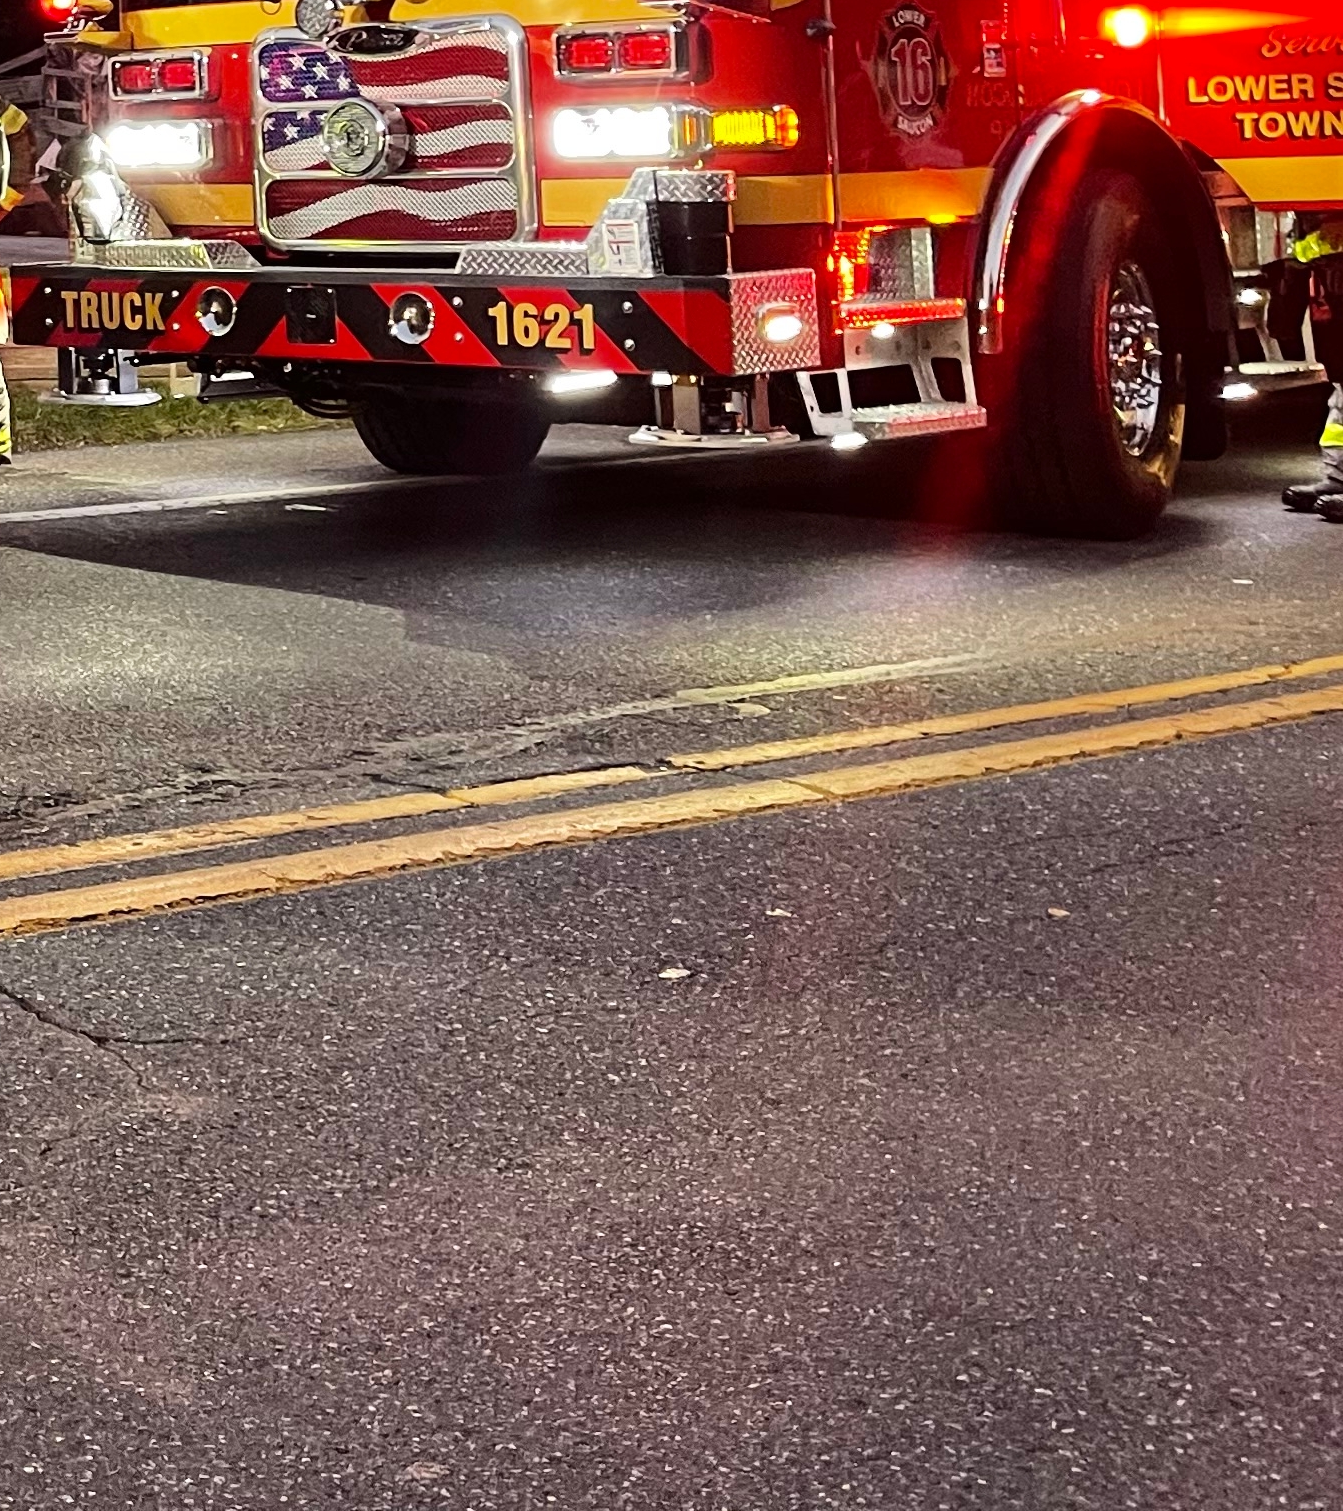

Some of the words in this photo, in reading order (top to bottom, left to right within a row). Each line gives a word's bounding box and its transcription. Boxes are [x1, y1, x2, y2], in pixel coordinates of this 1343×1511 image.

[891, 37, 933, 106] 16
[1187, 74, 1315, 104] LOWER
[61, 291, 166, 332] TRUCK
[488, 301, 596, 351] 1621
